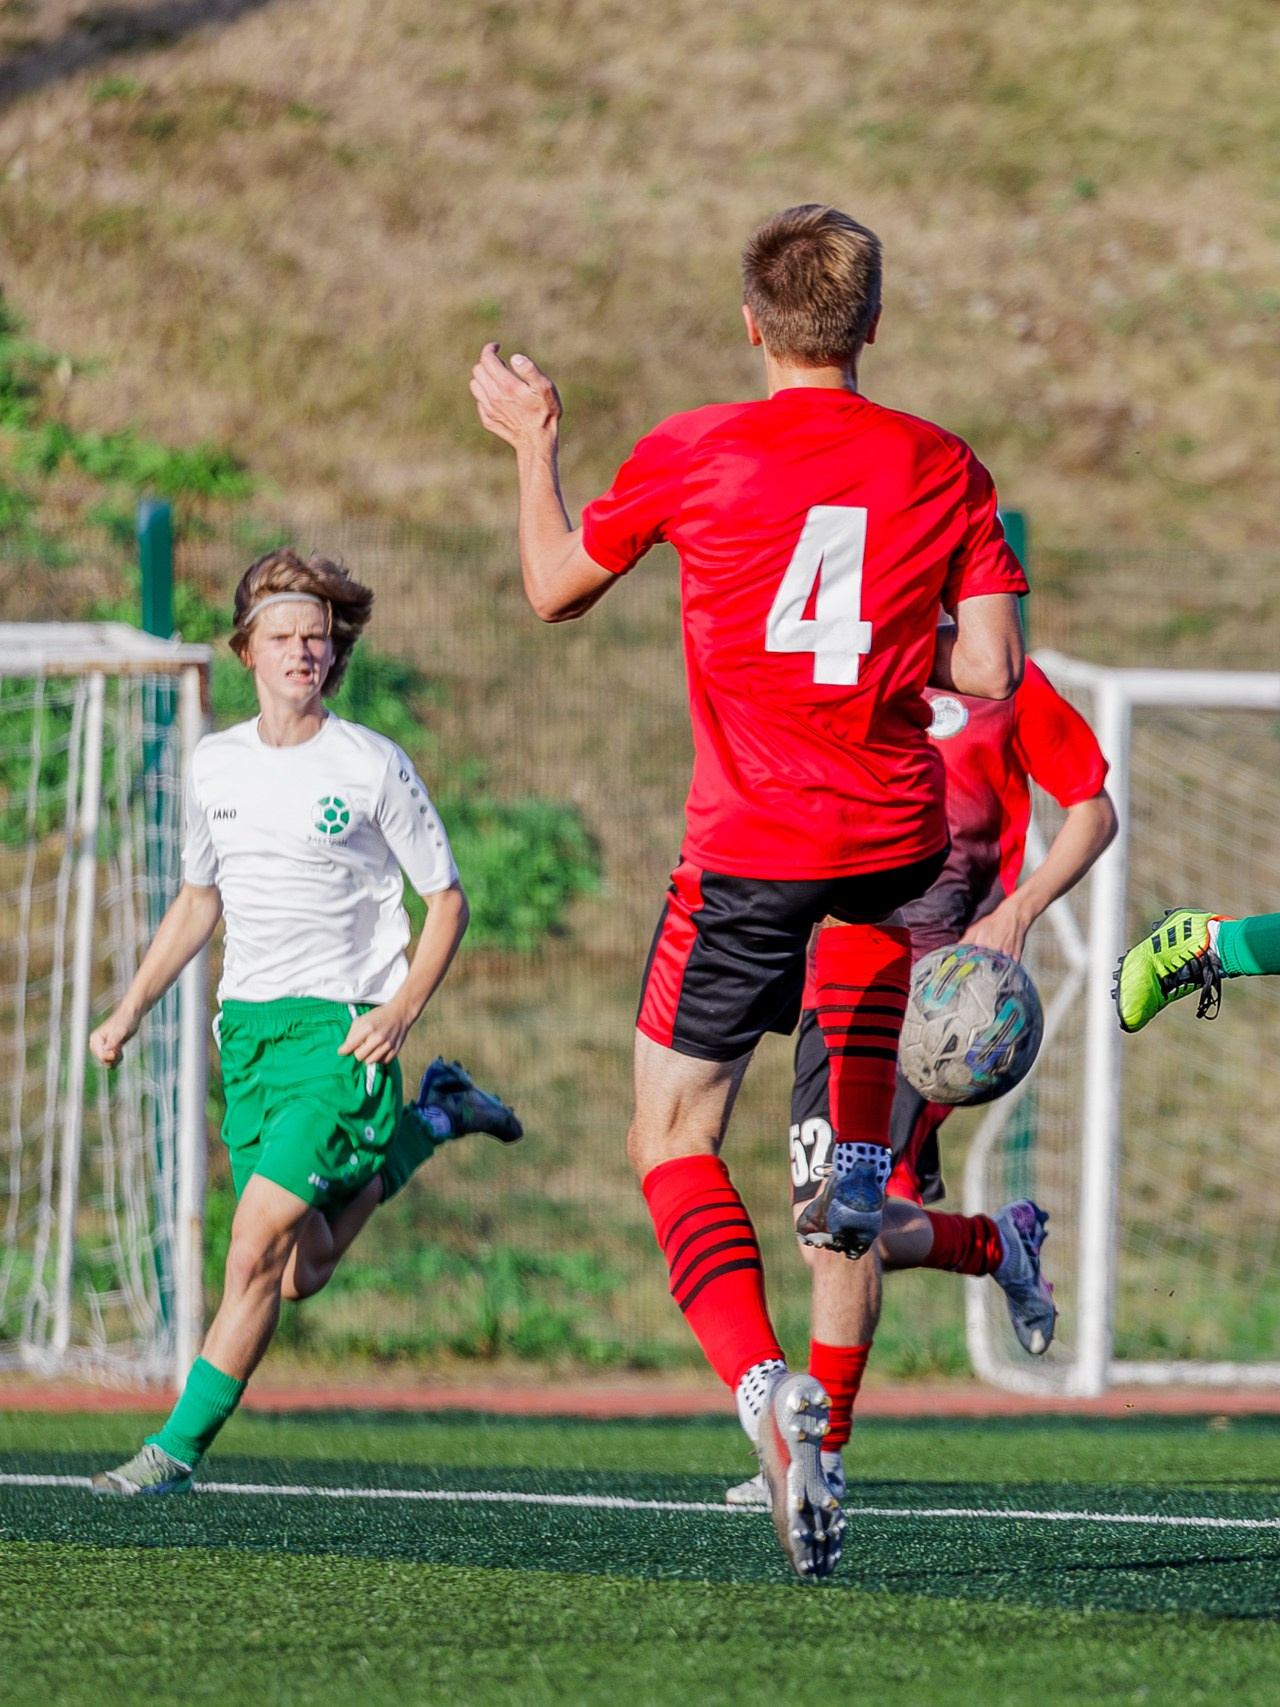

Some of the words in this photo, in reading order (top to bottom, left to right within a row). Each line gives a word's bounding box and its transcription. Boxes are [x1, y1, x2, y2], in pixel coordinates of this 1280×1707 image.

[765, 504, 872, 685] 4
[212, 808, 237, 820] JAKO
[789, 1116, 832, 1187] 52
